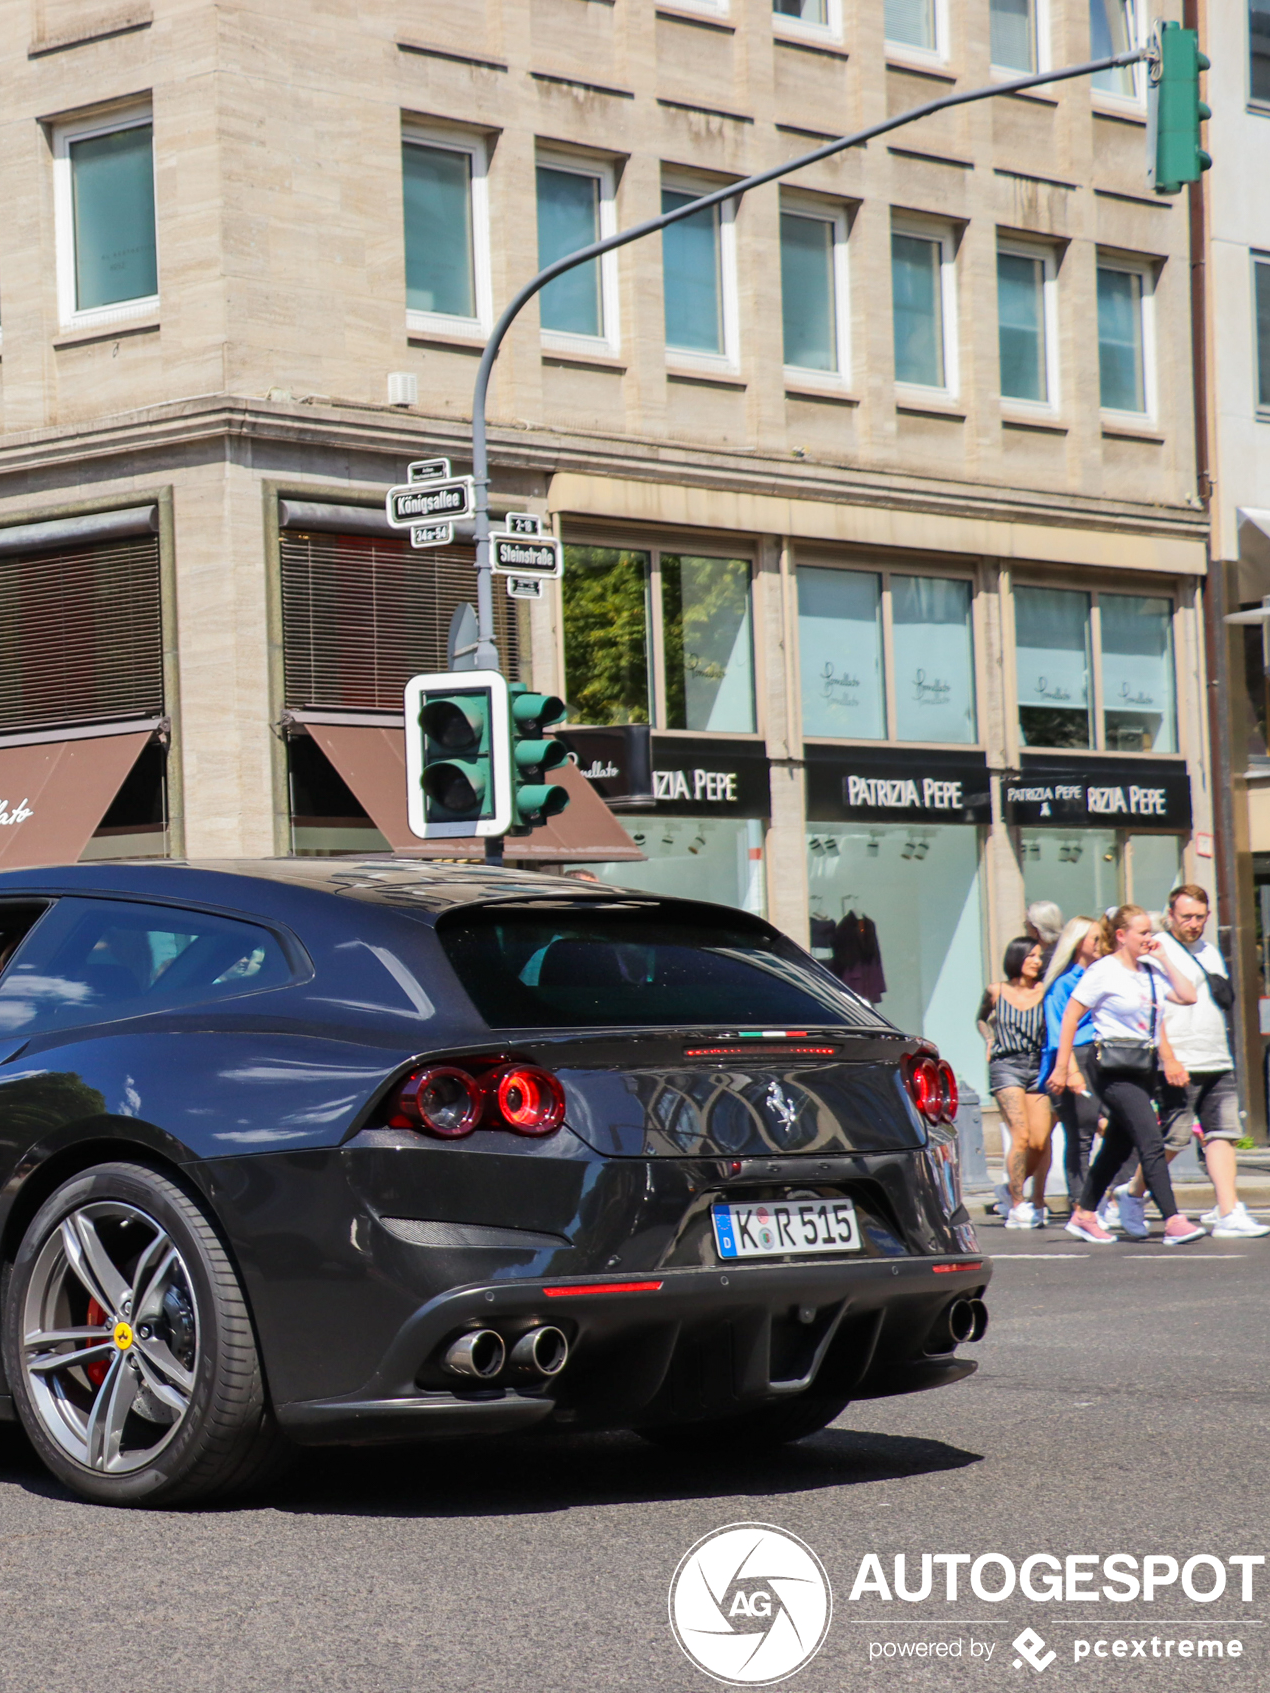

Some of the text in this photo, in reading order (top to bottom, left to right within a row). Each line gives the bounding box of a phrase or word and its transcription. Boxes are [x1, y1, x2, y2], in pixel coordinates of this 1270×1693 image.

[397, 490, 460, 516] Königsallee
[500, 544, 554, 566] Steinstraße
[652, 769, 738, 801] IZIA PEPE
[848, 775, 963, 809] PATRIZIA PEPE
[1007, 785, 1082, 801] PATRIZIA PEPE
[1087, 785, 1166, 815] RIZIA PEPE
[736, 1204, 852, 1249] K R 515
[723, 1237, 731, 1249] D
